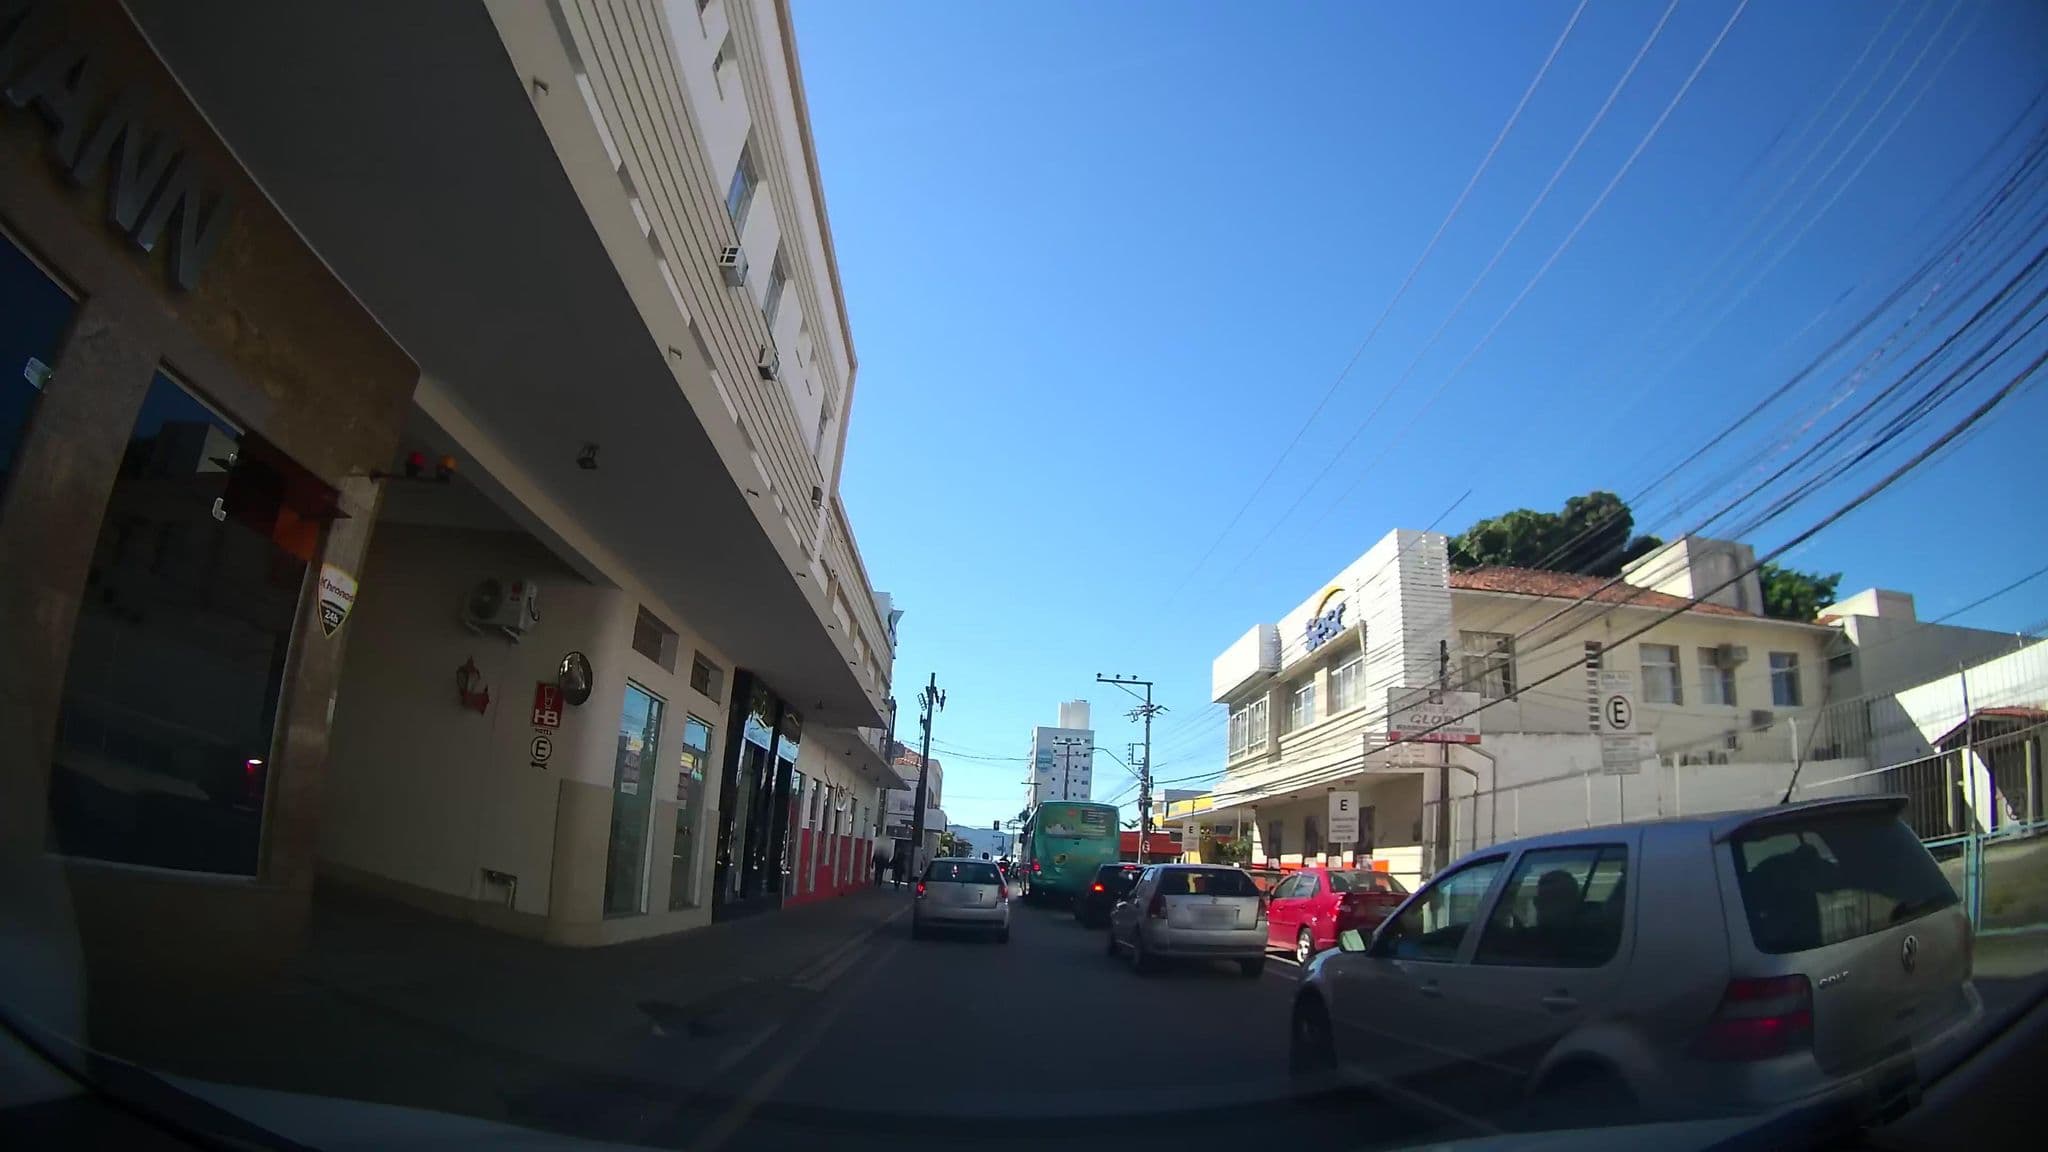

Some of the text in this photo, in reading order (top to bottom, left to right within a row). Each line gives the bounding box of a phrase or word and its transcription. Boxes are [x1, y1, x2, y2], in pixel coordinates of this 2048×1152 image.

[533, 708, 559, 727] HB
[1613, 701, 1625, 723] E
[535, 740, 547, 758] E
[1340, 799, 1348, 811] E
